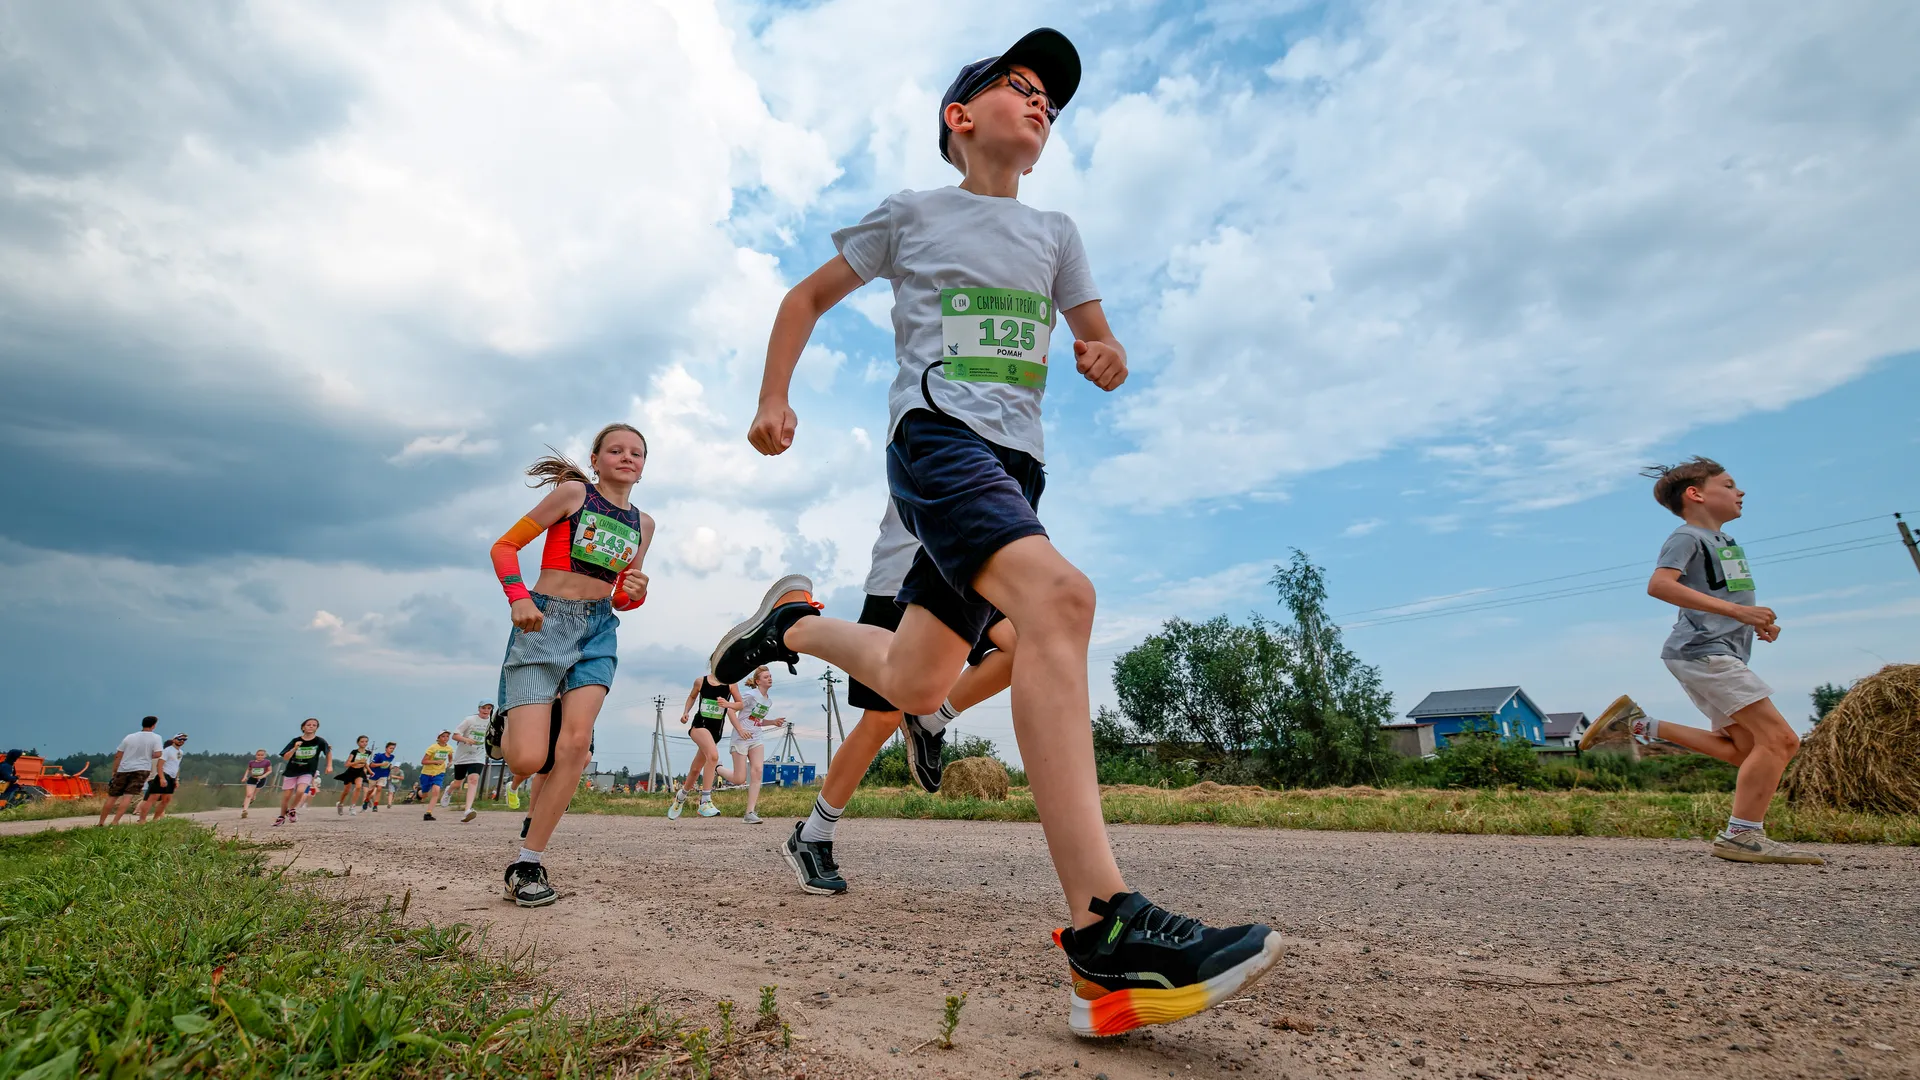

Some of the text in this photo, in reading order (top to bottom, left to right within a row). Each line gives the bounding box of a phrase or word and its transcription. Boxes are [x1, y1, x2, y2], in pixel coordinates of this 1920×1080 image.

[977, 294, 1037, 315] СЫРНЫЙ ТРЕЙЛ
[979, 318, 1036, 351] 125
[997, 349, 1023, 358] РОМАН
[594, 531, 626, 554] 143
